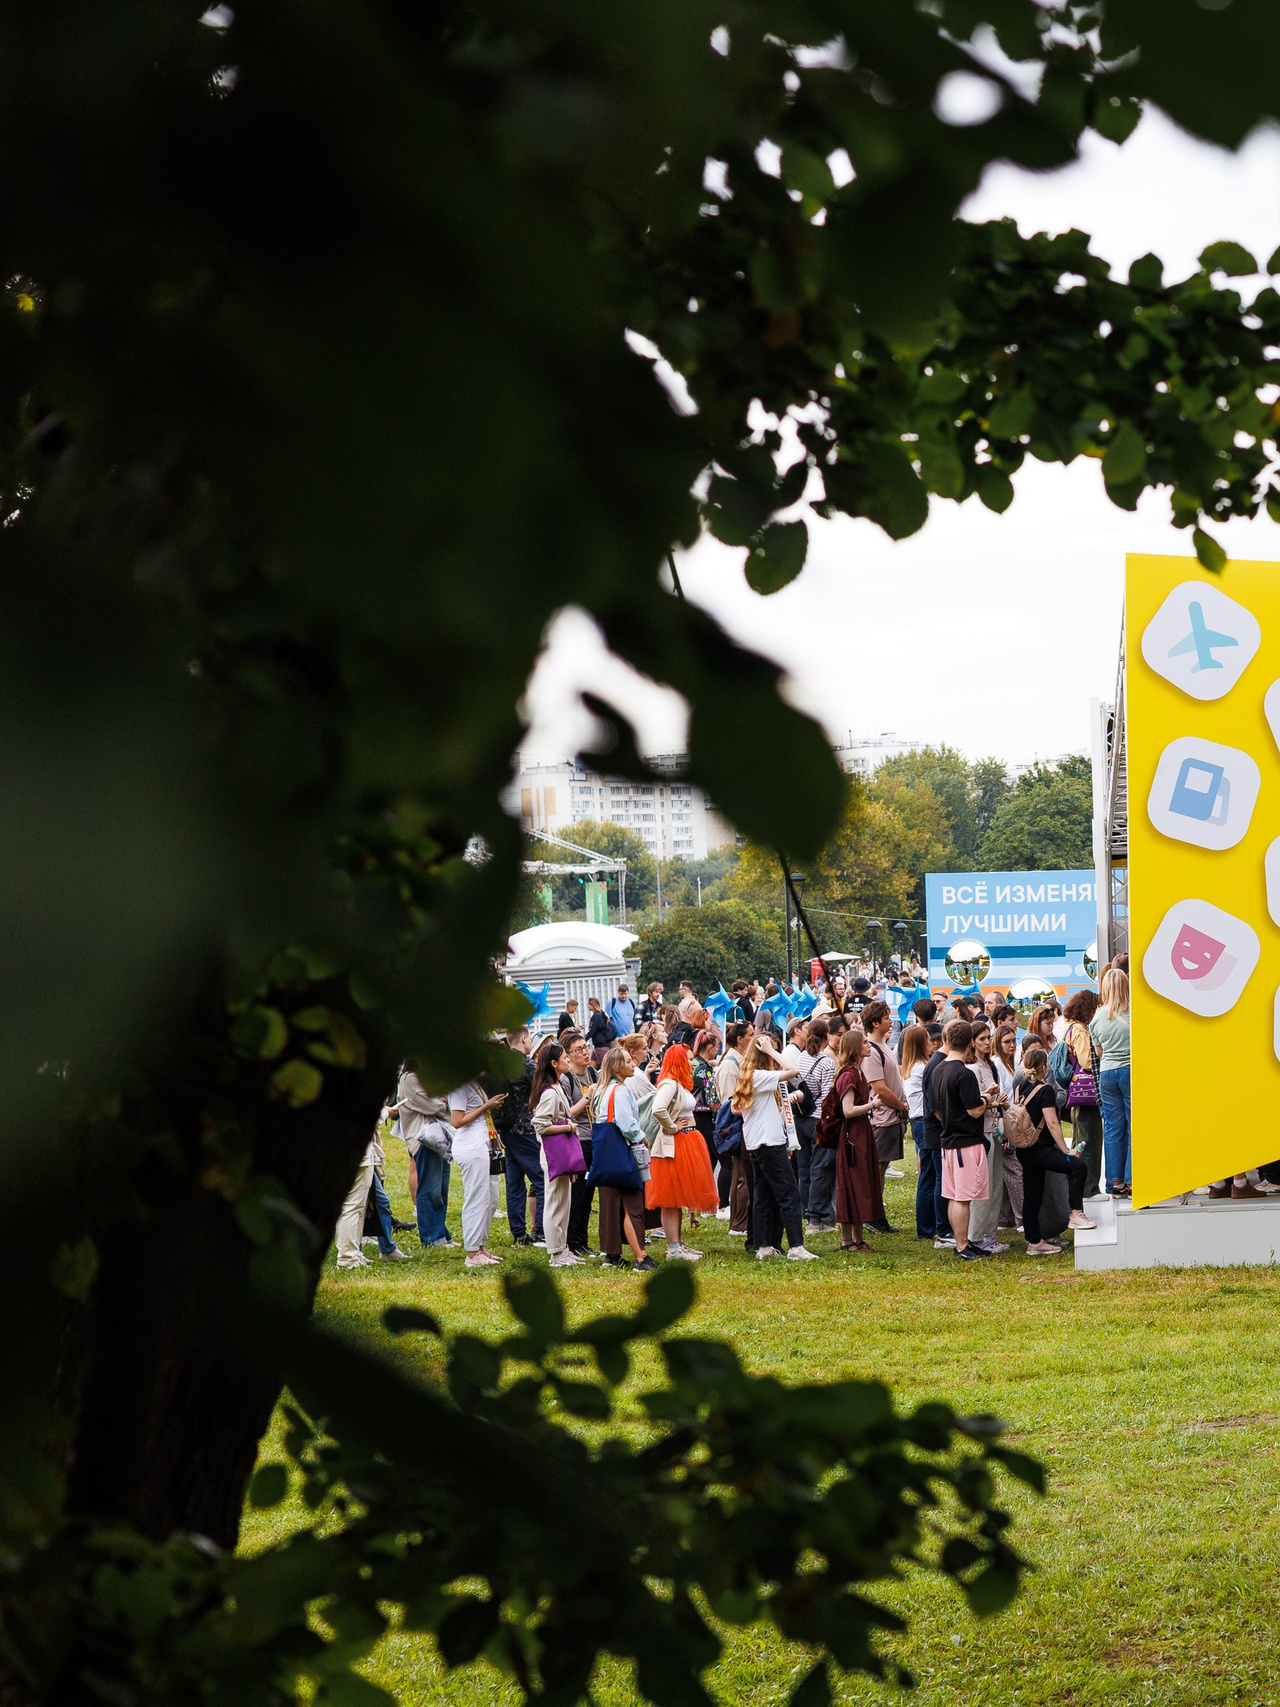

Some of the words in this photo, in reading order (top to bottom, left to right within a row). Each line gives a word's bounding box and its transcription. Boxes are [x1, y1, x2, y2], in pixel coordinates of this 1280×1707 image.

[942, 881, 988, 904] ВСЁ
[996, 883, 1098, 903] ИЗМЕНЯ
[942, 913, 1067, 934] ЛУЧШИМИ
[780, 1083, 788, 1099] BIG
[783, 1099, 793, 1125] TECH
